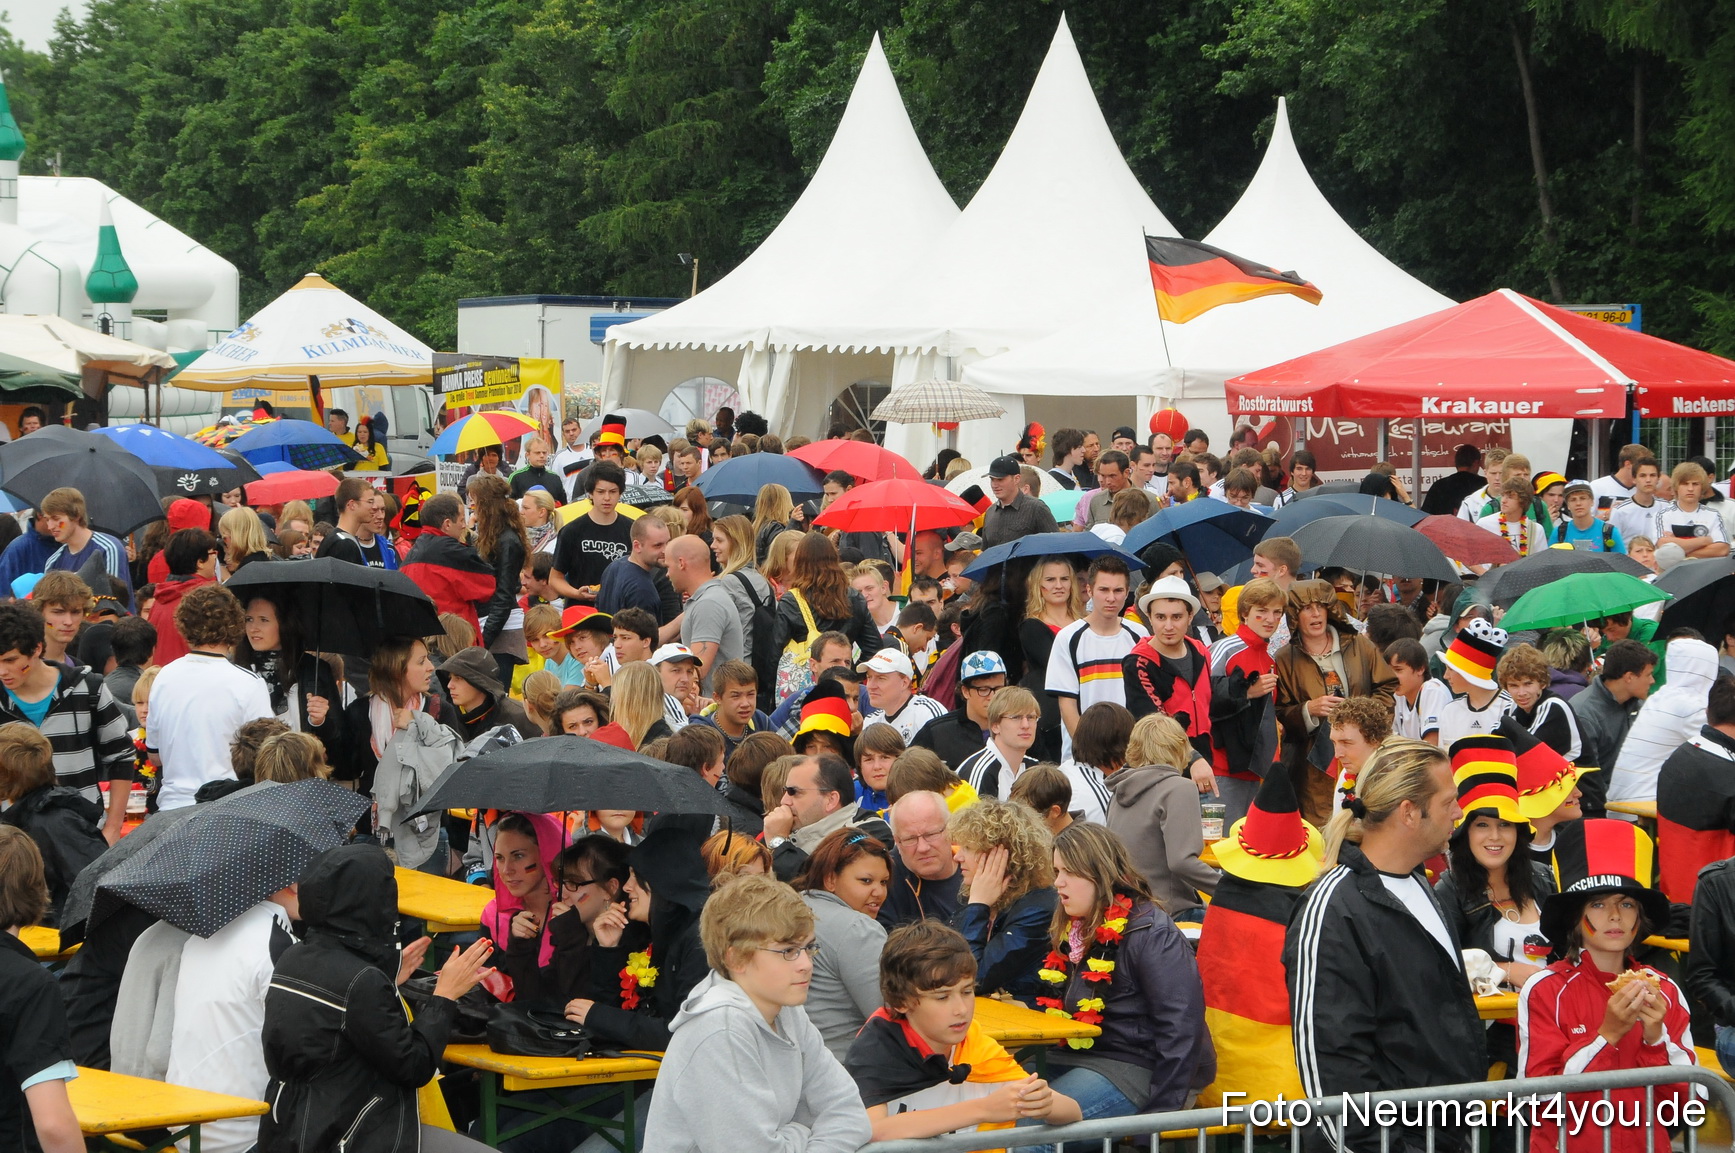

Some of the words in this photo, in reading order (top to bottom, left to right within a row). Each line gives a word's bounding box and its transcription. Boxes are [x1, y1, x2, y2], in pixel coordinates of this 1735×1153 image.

[1603, 311, 1627, 323] 96-0
[301, 335, 426, 360] KULMBACHER
[1238, 395, 1314, 412] Rostbratwurst
[1421, 395, 1544, 415] Krakauer
[1672, 396, 1735, 414] Nackens
[1305, 417, 1365, 446] Mai
